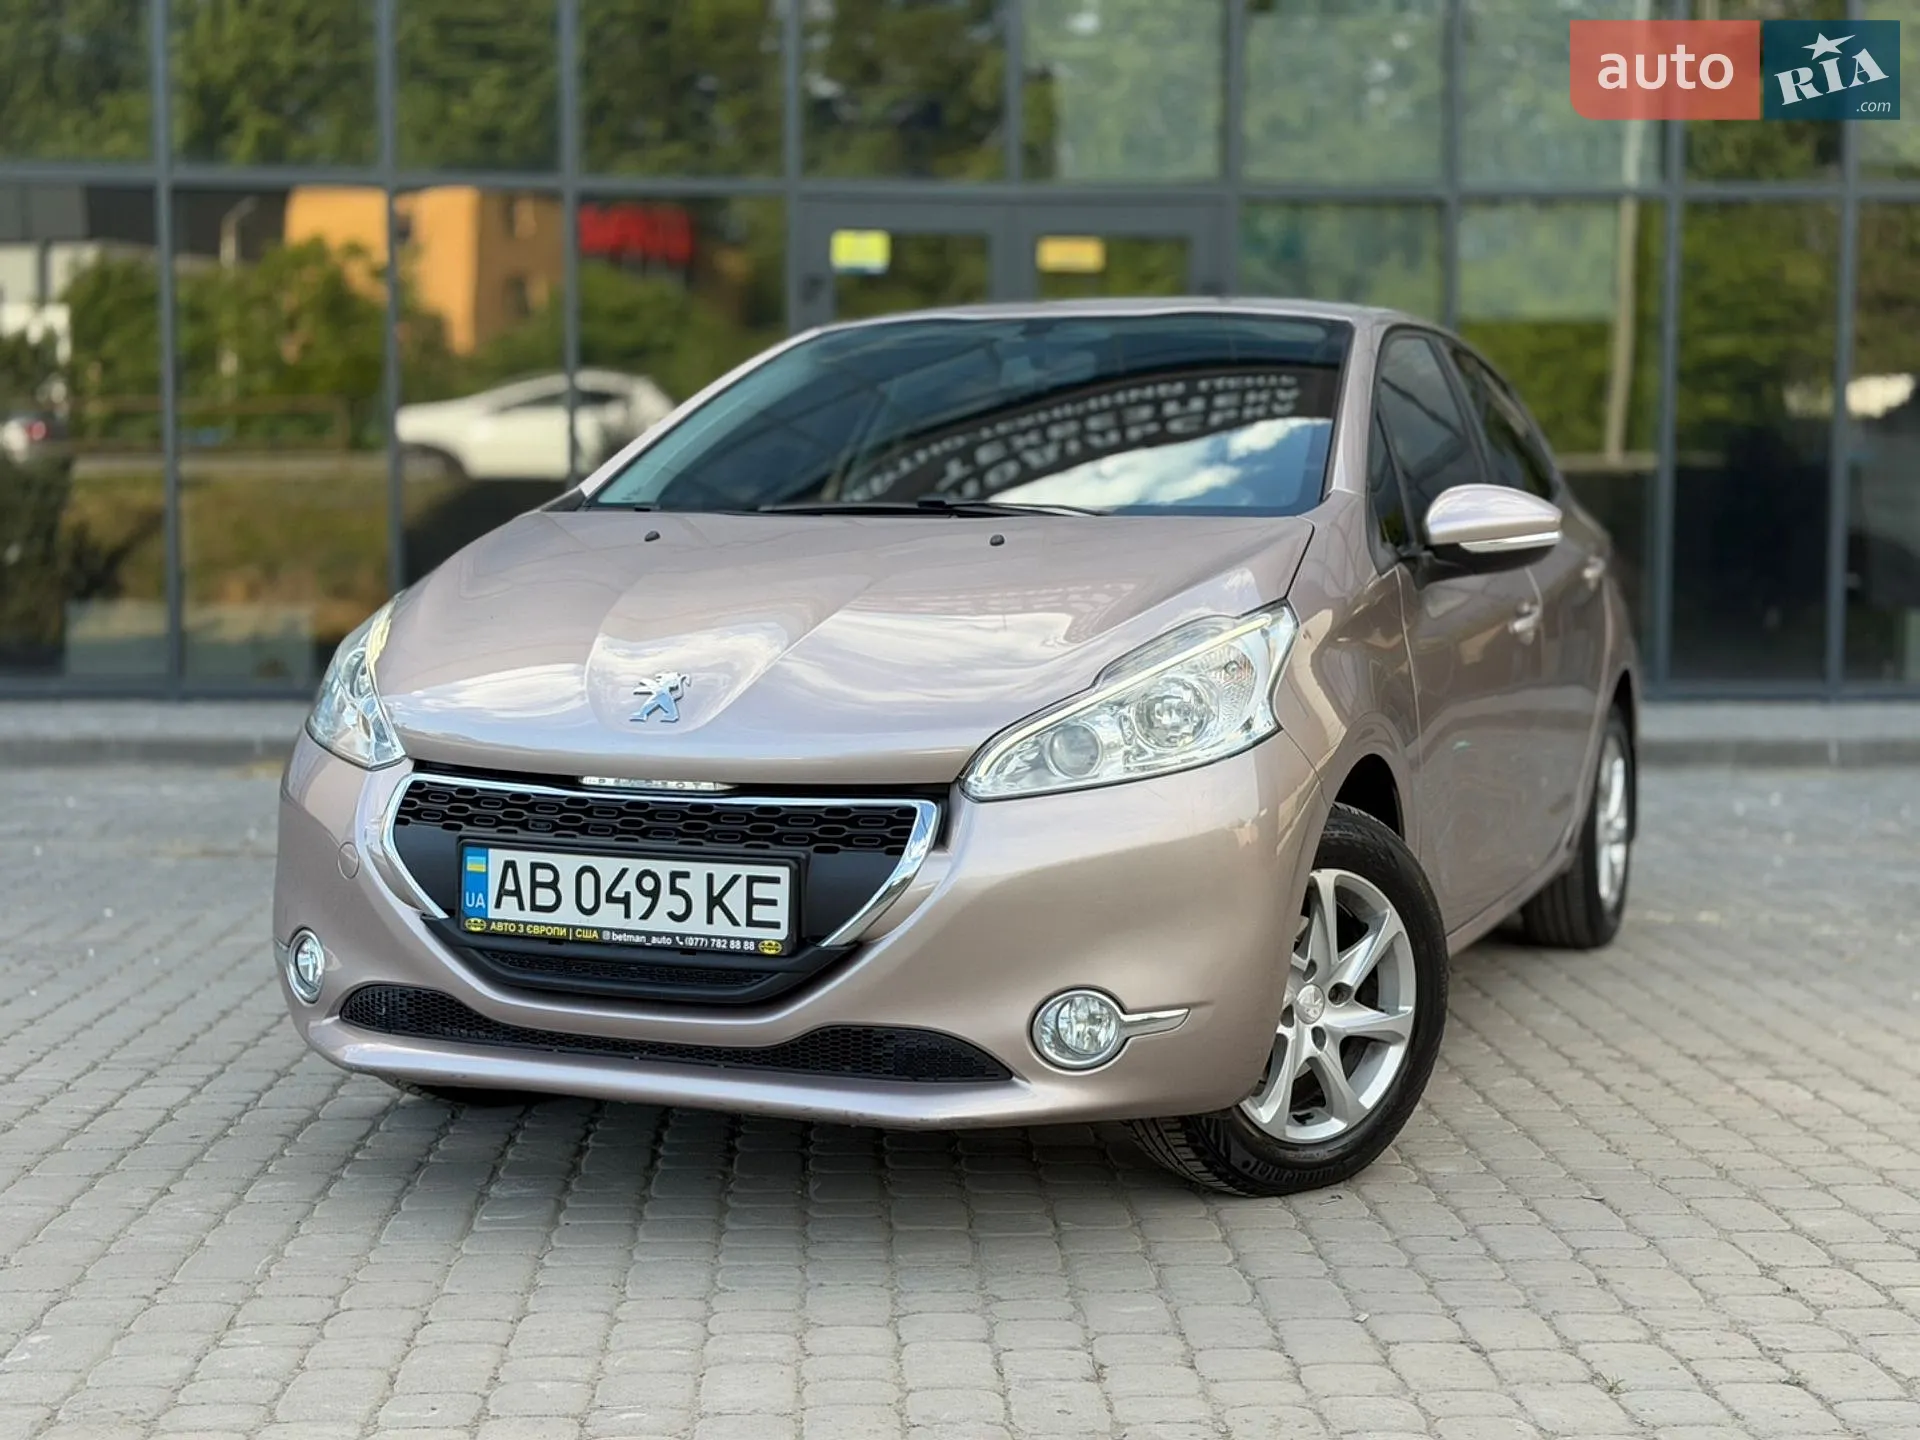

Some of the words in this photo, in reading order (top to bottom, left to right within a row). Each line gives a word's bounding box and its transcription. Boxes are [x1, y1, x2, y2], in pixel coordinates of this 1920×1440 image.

[465, 894, 487, 910] UA
[574, 865, 694, 924] 0495
[575, 927, 599, 940] США
[685, 937, 709, 948] (077)
[710, 937, 727, 949] 782
[729, 939, 742, 950] 88
[743, 940, 756, 951] 88
